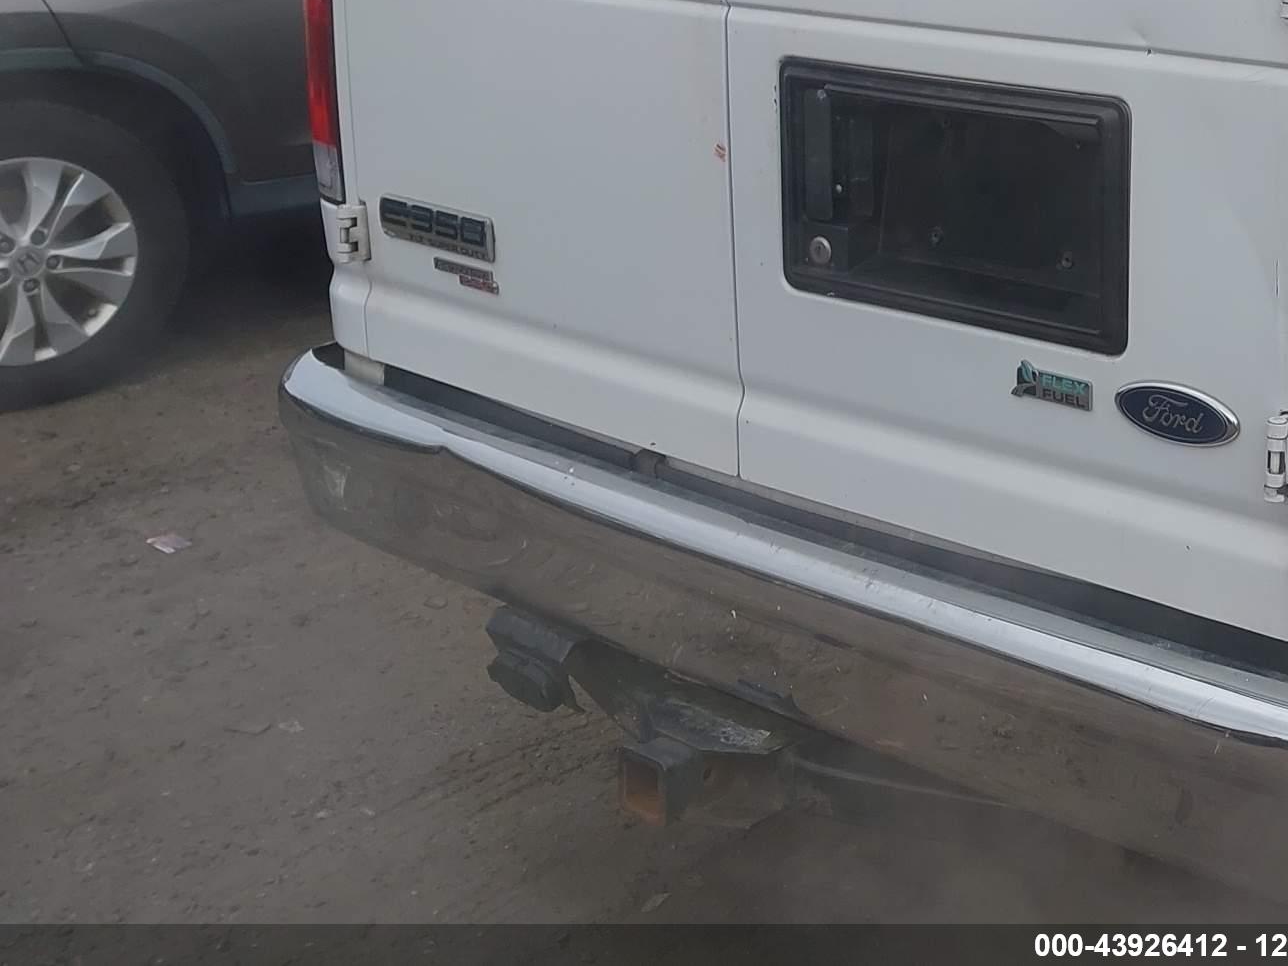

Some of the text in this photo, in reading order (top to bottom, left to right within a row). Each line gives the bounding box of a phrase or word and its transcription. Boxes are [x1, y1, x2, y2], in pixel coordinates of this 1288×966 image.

[1041, 374, 1087, 395] FLEX
[1041, 388, 1087, 409] FUEL
[1142, 393, 1204, 435] Ford
